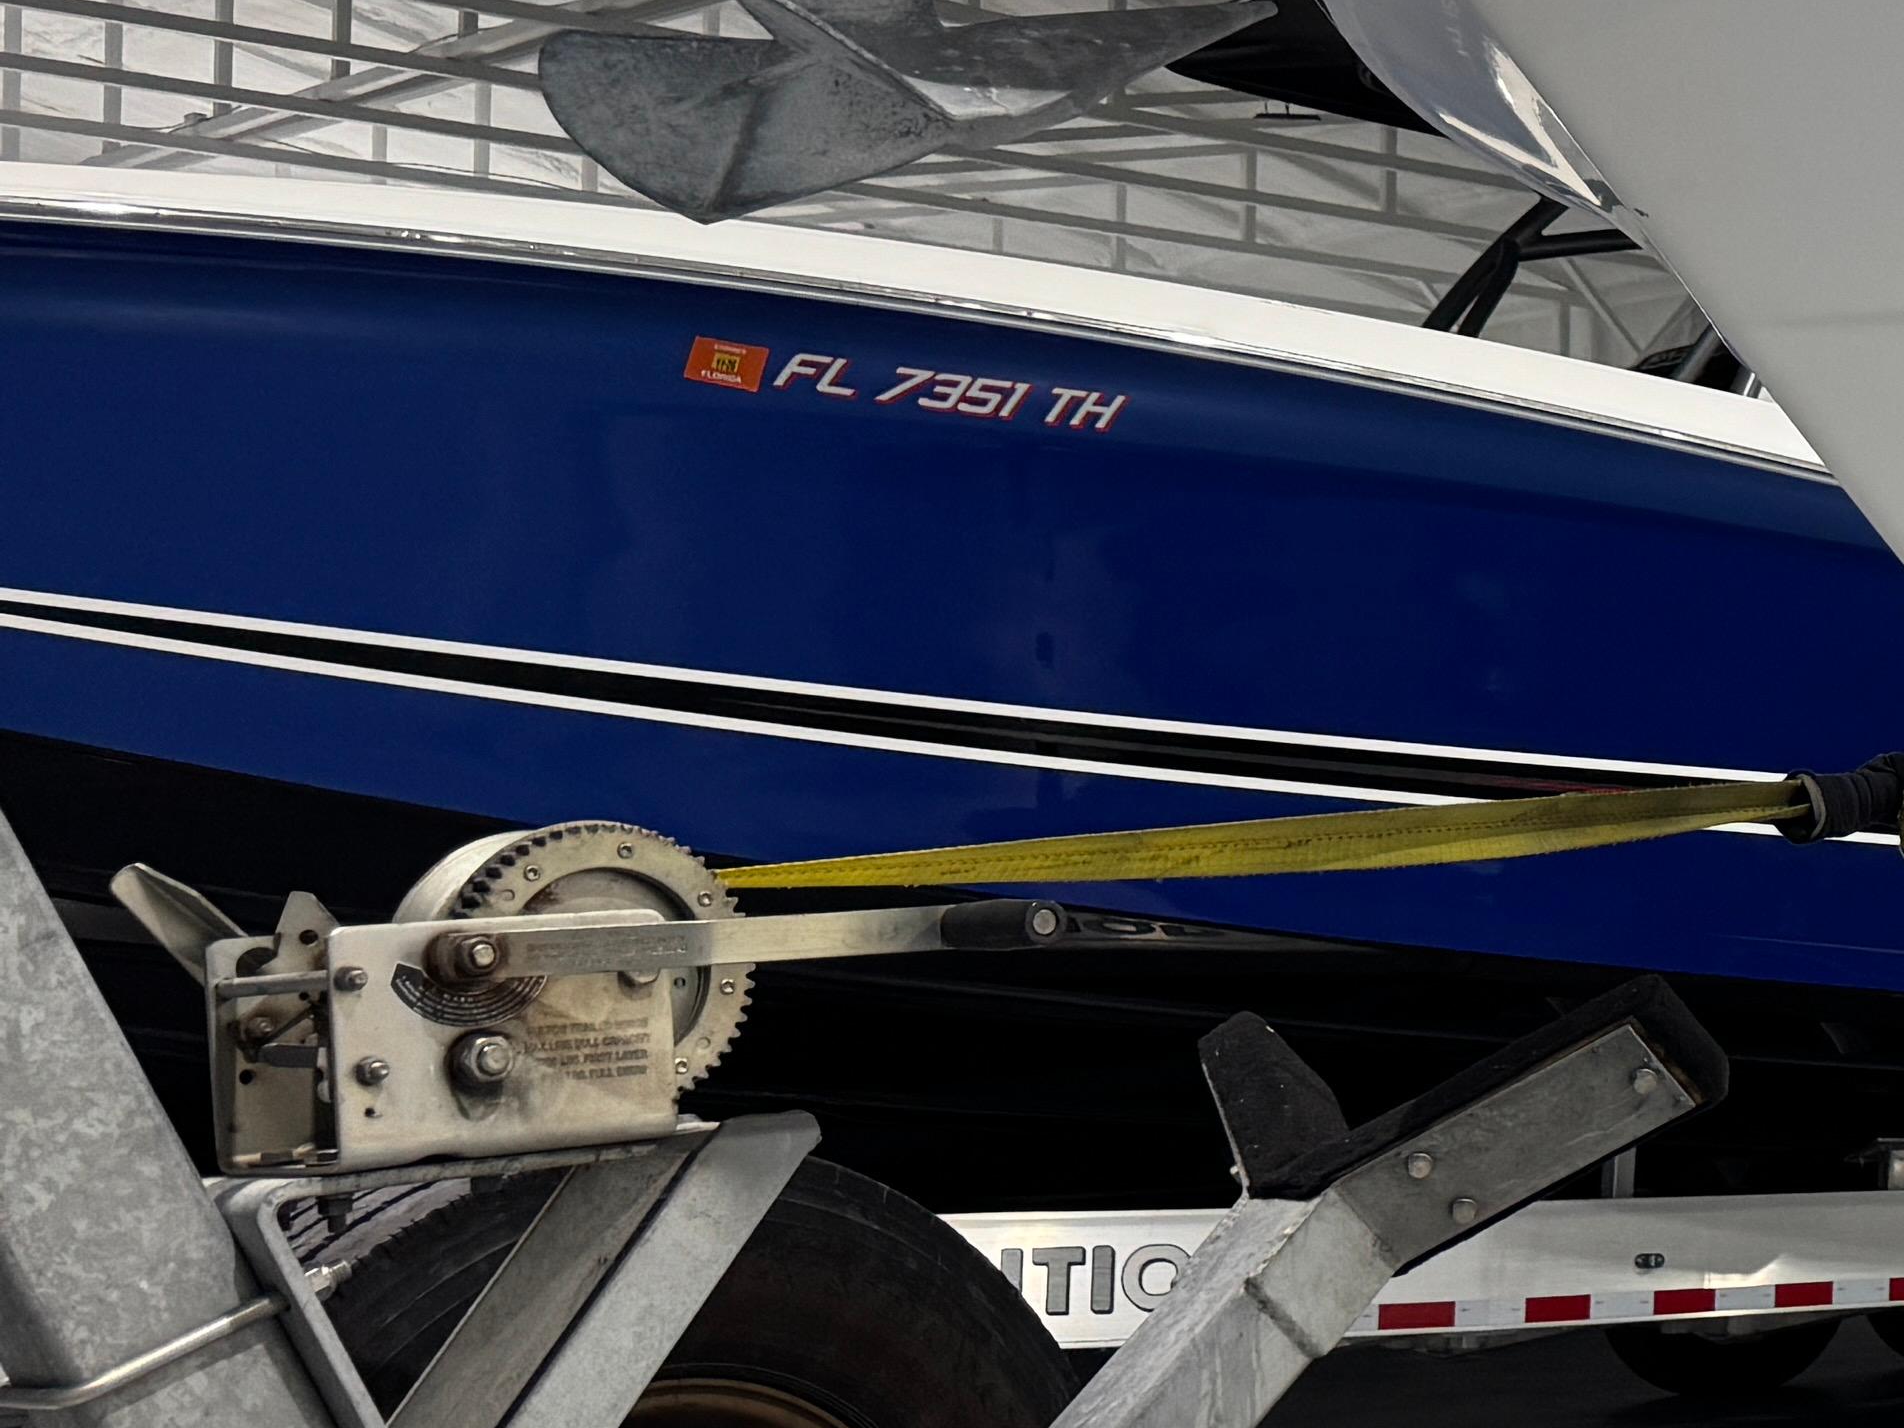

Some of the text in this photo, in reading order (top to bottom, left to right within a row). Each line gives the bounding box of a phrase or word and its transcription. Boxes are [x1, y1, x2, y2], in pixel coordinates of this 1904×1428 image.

[773, 353, 1128, 431] FL 7351 TH
